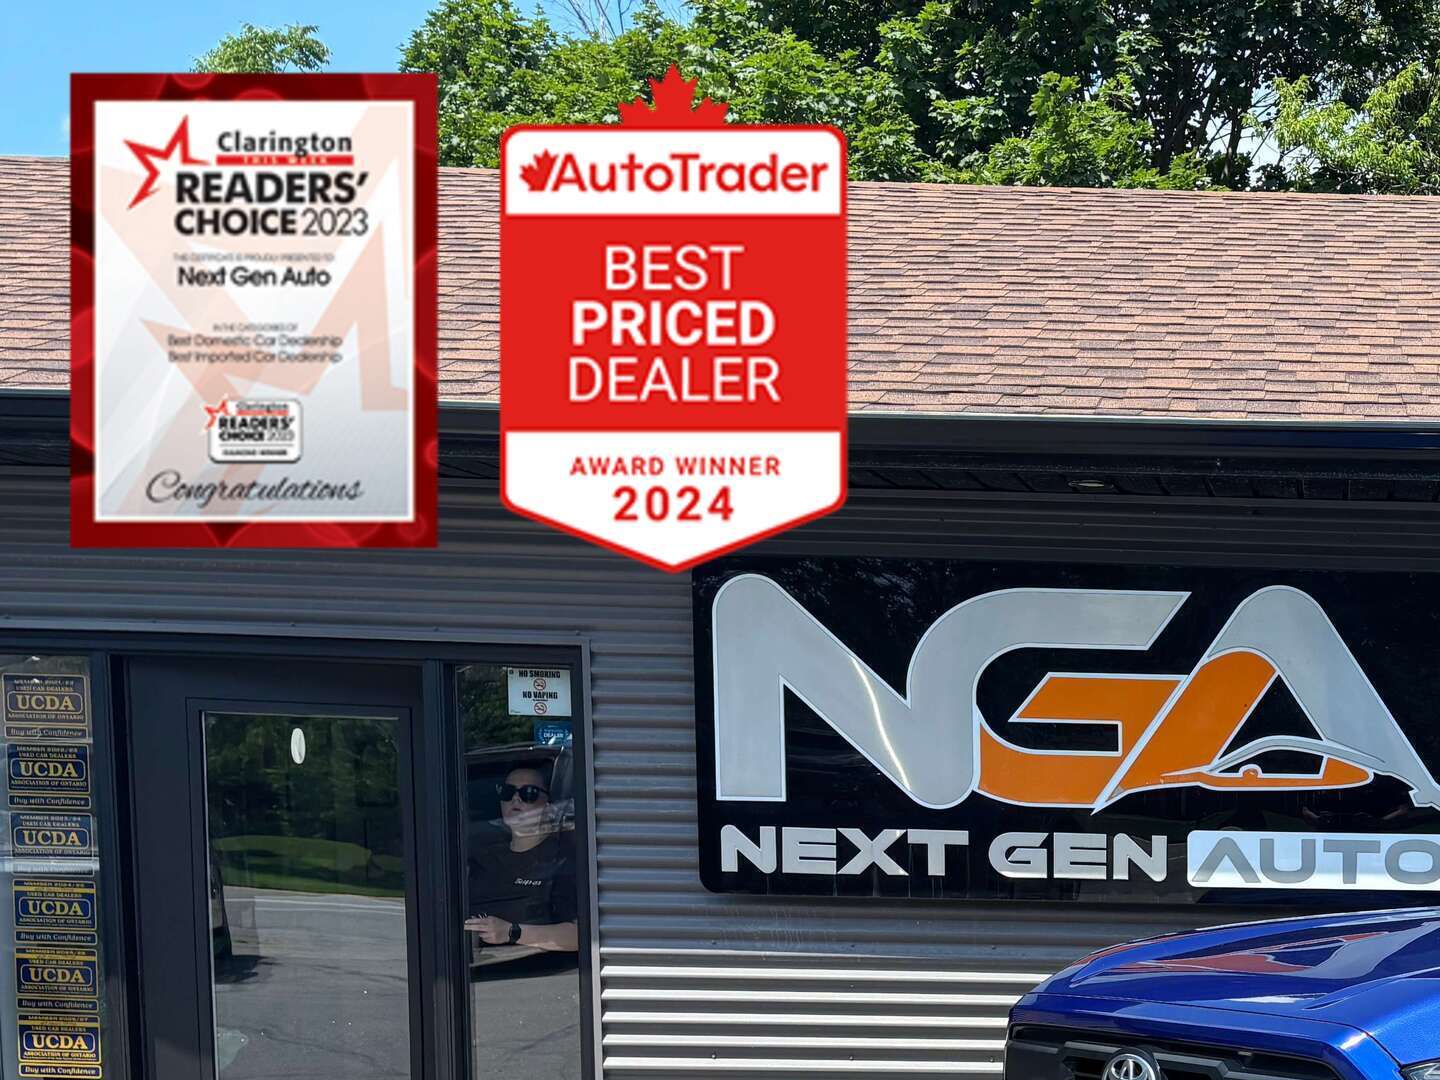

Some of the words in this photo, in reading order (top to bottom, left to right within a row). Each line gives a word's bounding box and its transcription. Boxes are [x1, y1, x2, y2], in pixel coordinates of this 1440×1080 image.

[518, 670, 528, 678] NO
[529, 670, 561, 679] SMOKING
[16, 694, 76, 711] UCDA
[522, 691, 532, 699] NO
[533, 691, 558, 700] VAPING
[19, 761, 78, 777] UCDA
[22, 829, 82, 846] UCDA
[720, 823, 970, 876] NEXT
[987, 830, 1169, 883] GEN
[27, 900, 84, 916] UCDA
[28, 967, 85, 983] UCDA
[31, 1034, 88, 1050] UCDA
